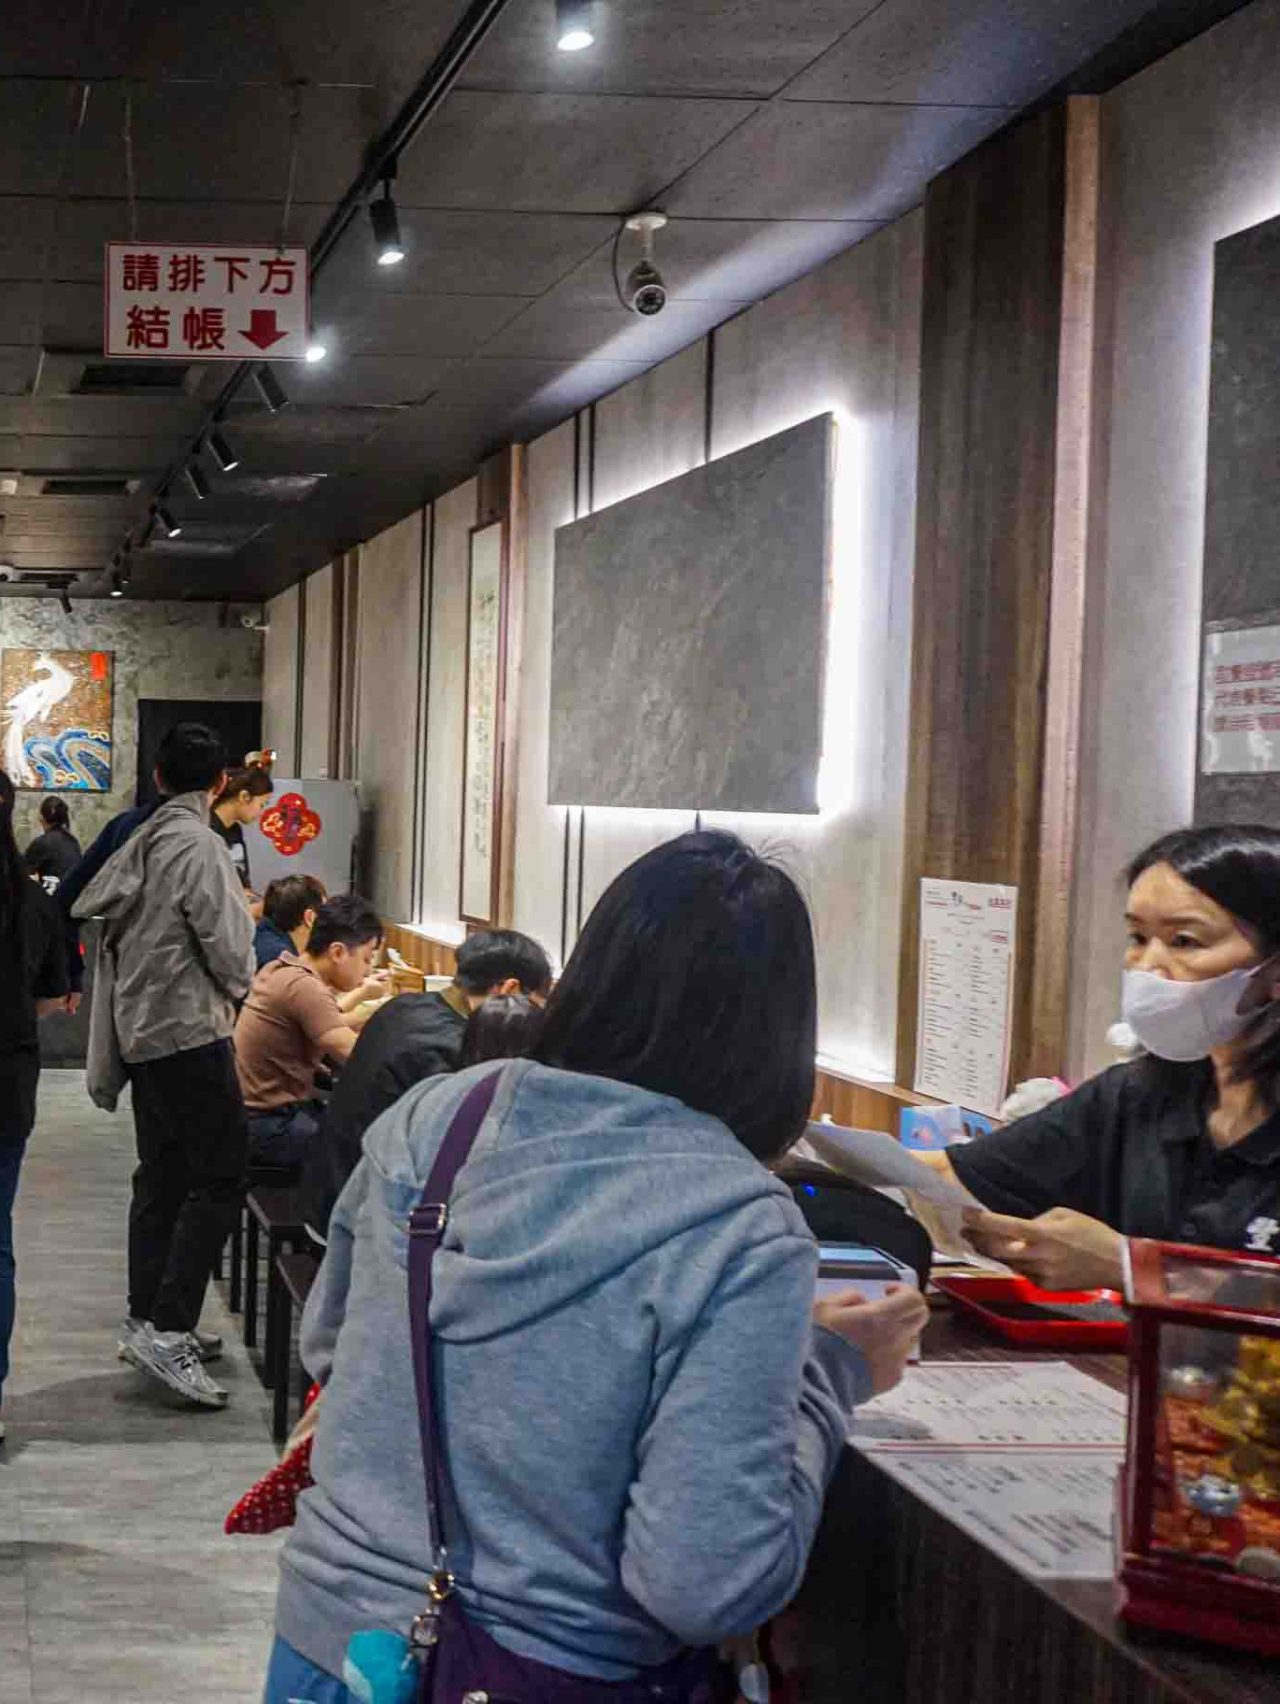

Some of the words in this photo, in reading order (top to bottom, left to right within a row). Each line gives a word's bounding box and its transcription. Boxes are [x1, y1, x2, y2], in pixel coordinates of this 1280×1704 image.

[122, 253, 296, 295] 請排下方
[126, 304, 226, 351] 結帳
